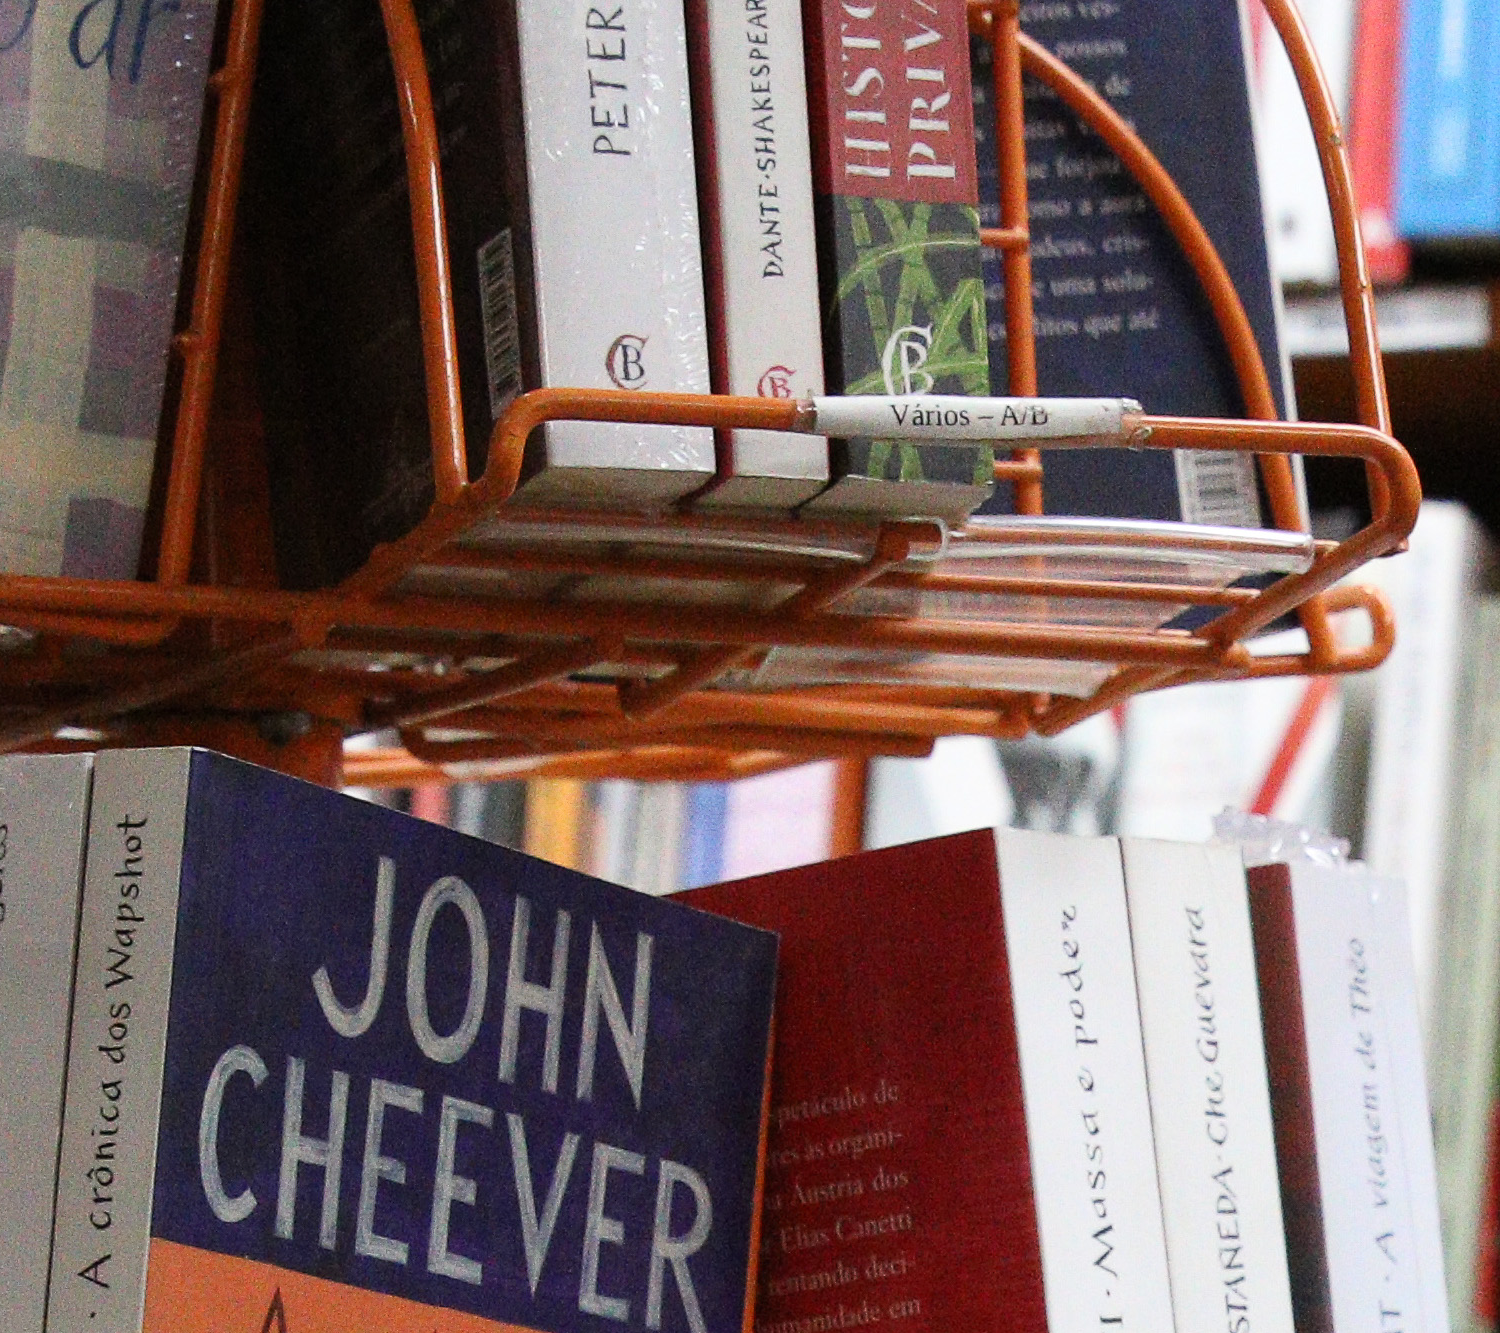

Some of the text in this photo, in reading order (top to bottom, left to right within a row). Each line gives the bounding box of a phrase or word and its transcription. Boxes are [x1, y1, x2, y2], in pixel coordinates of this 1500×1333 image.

[593, 5, 630, 156] PETER
[902, 0, 957, 181] PRIV
[890, 399, 1049, 427] Vários A/B
[102, 811, 148, 992] Wapshot
[97, 1002, 131, 1063] dos
[311, 855, 655, 1112] JOHN
[1058, 903, 1102, 1051] poder
[1186, 904, 1223, 1061] Guevara
[80, 1077, 123, 1232] crônica
[1077, 1070, 1096, 1095] e
[1198, 1068, 1228, 1151] Che
[1085, 1108, 1126, 1274] Massa
[1375, 1231, 1399, 1267] A
[77, 1252, 112, 1290] A
